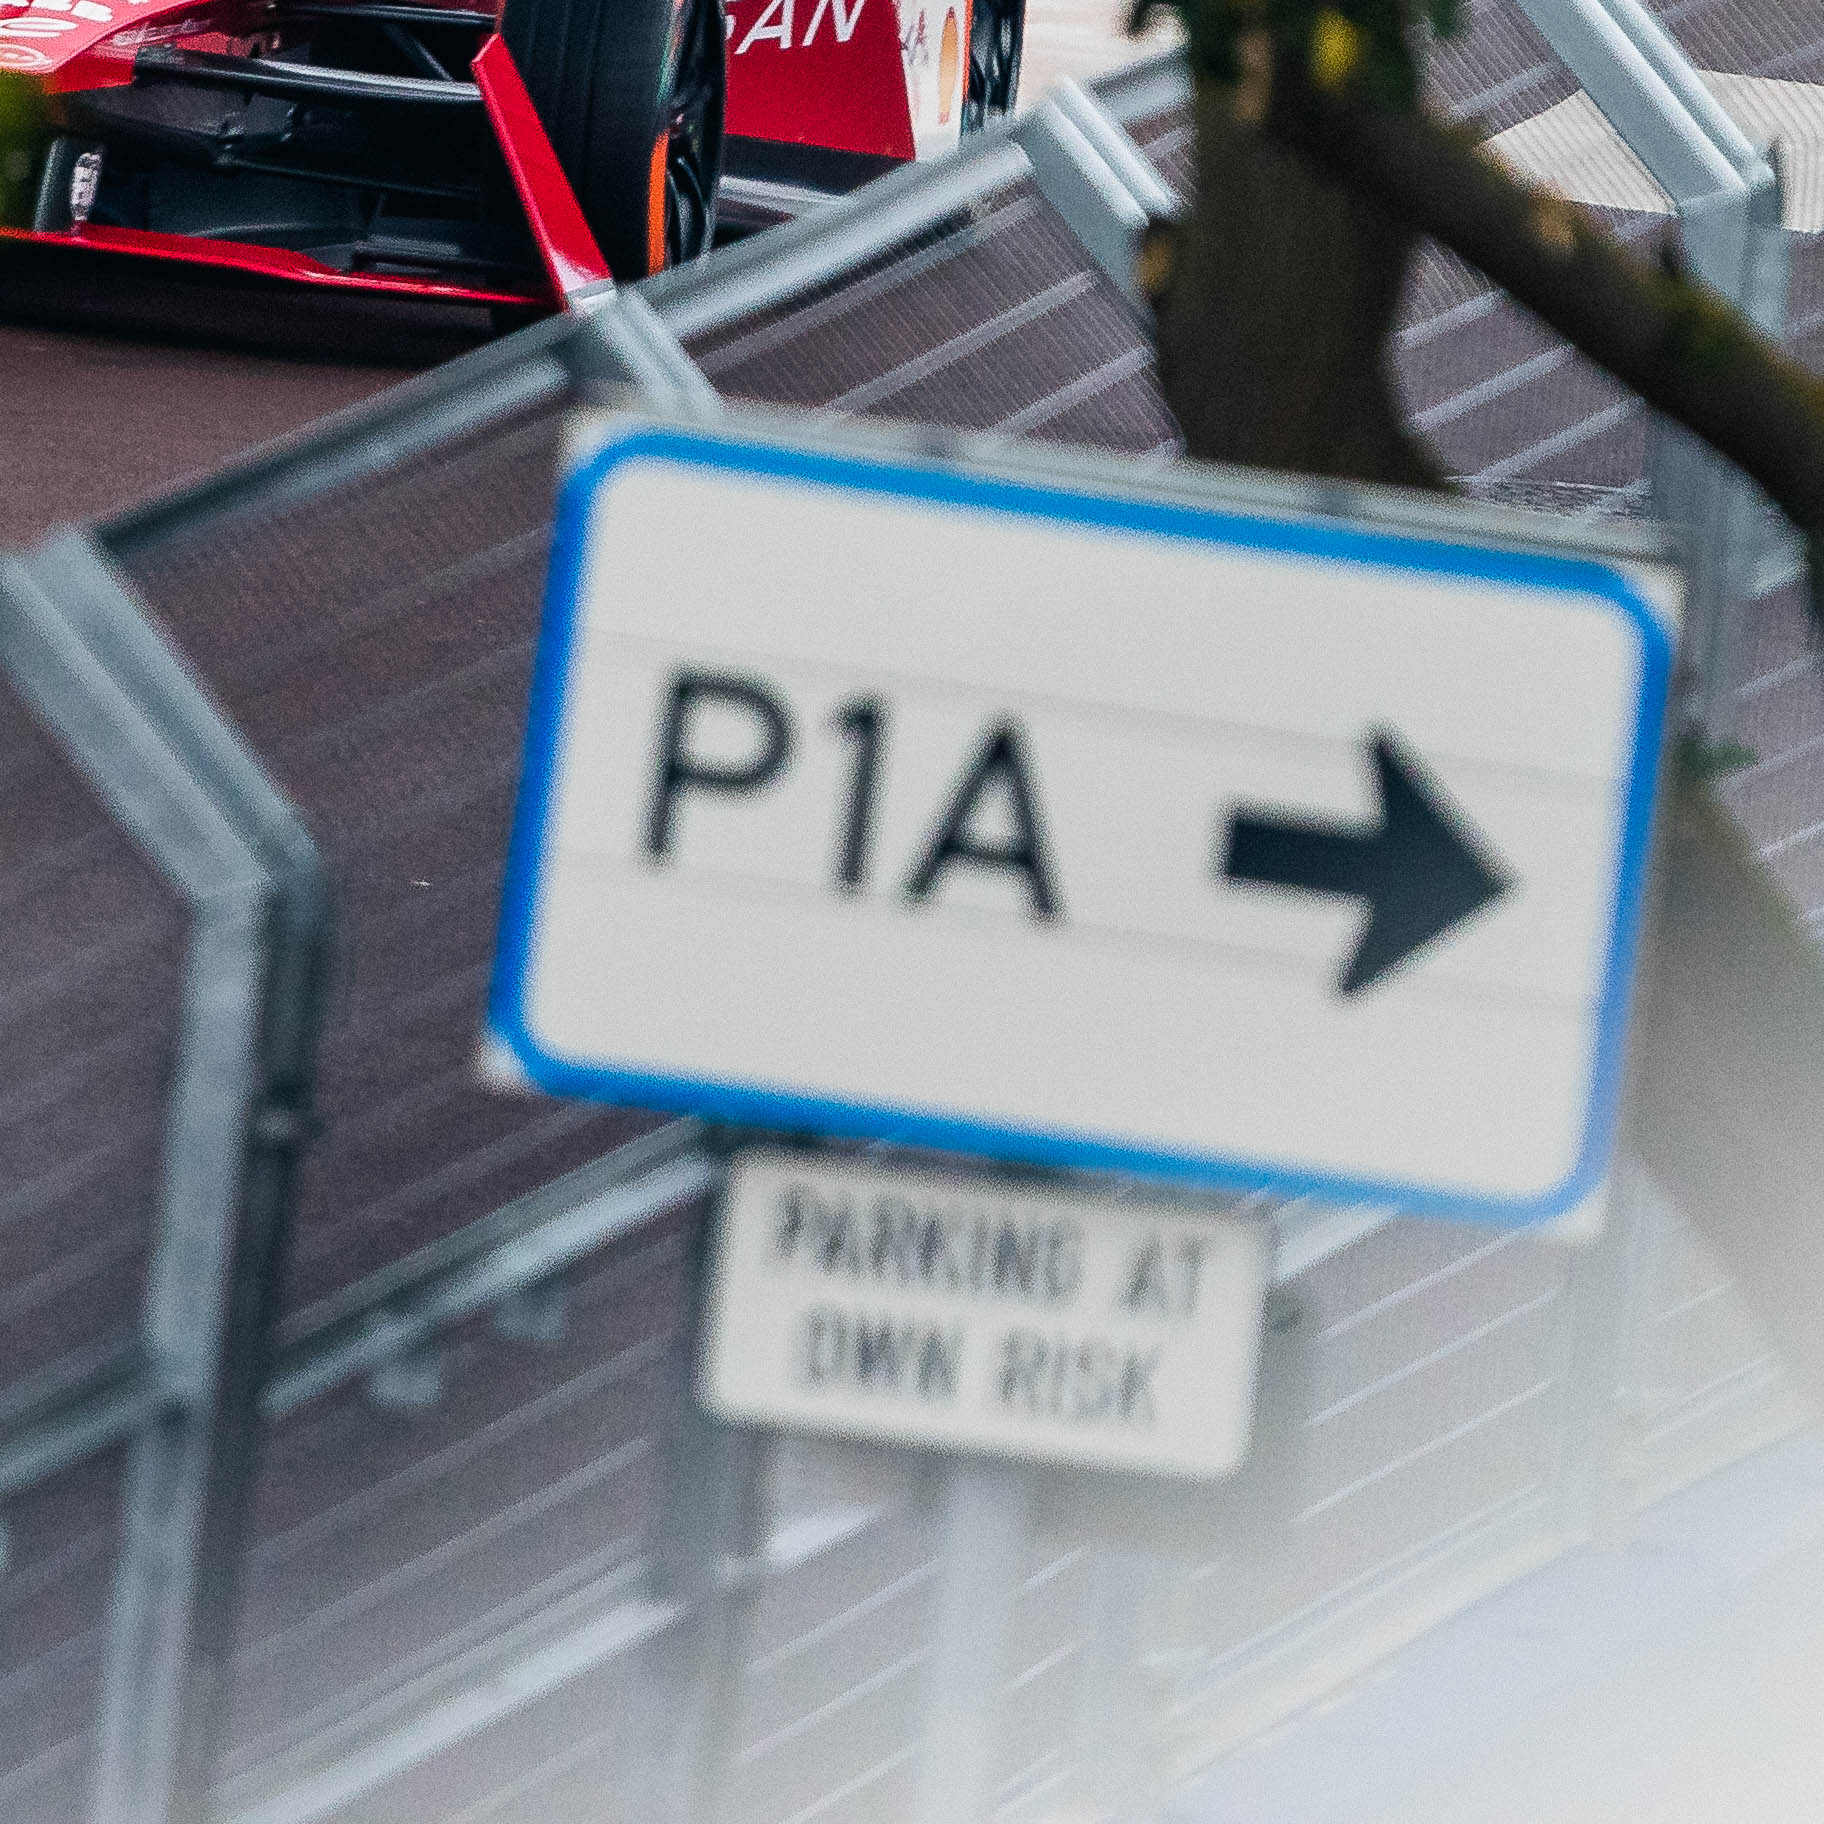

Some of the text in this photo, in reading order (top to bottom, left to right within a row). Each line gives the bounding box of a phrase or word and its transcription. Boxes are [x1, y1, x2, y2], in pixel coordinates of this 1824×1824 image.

[641, 664, 1067, 926] P1A
[773, 1182, 1213, 1318] PARKING AT
[991, 1326, 1160, 1426] RISK
